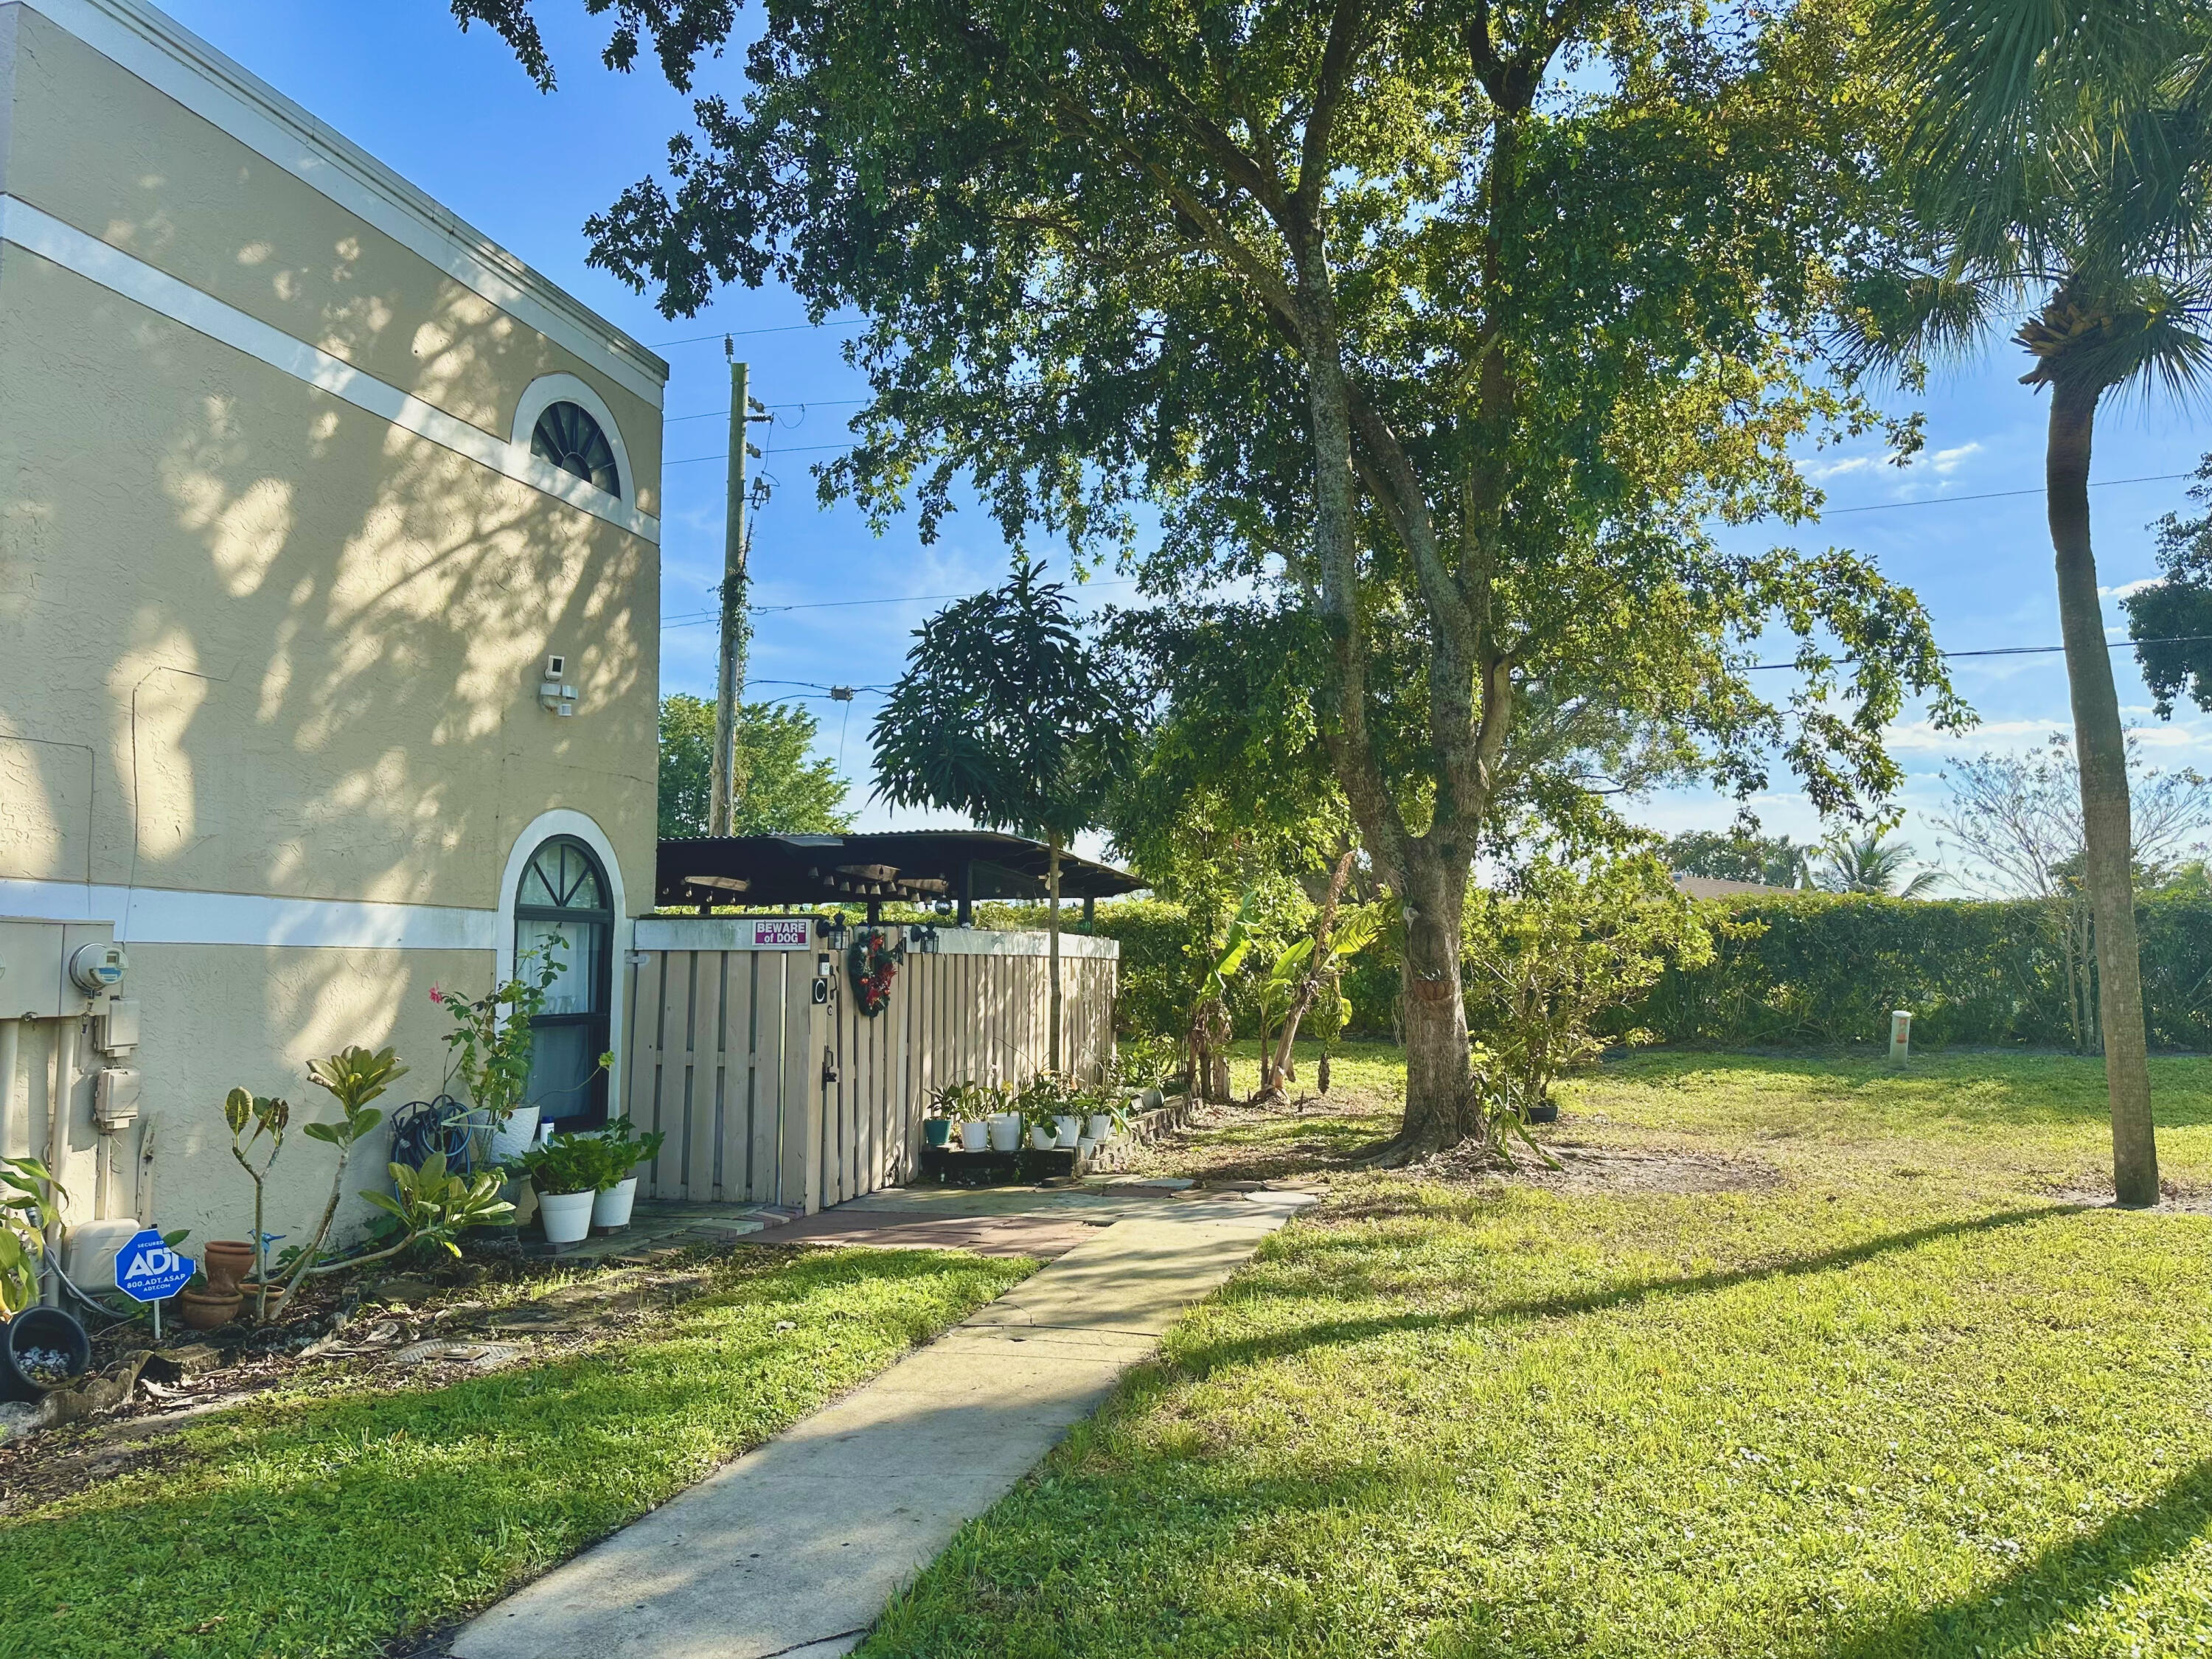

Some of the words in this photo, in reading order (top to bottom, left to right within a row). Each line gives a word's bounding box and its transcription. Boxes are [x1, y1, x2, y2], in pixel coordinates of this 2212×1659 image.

[757, 922, 805, 933] BEWARE
[764, 933, 773, 942] of
[776, 933, 798, 943] DOG
[815, 979, 825, 1002] C
[137, 1240, 164, 1248] SECURED
[125, 1247, 180, 1280] ADT
[143, 1284, 170, 1292] ADT.COM
